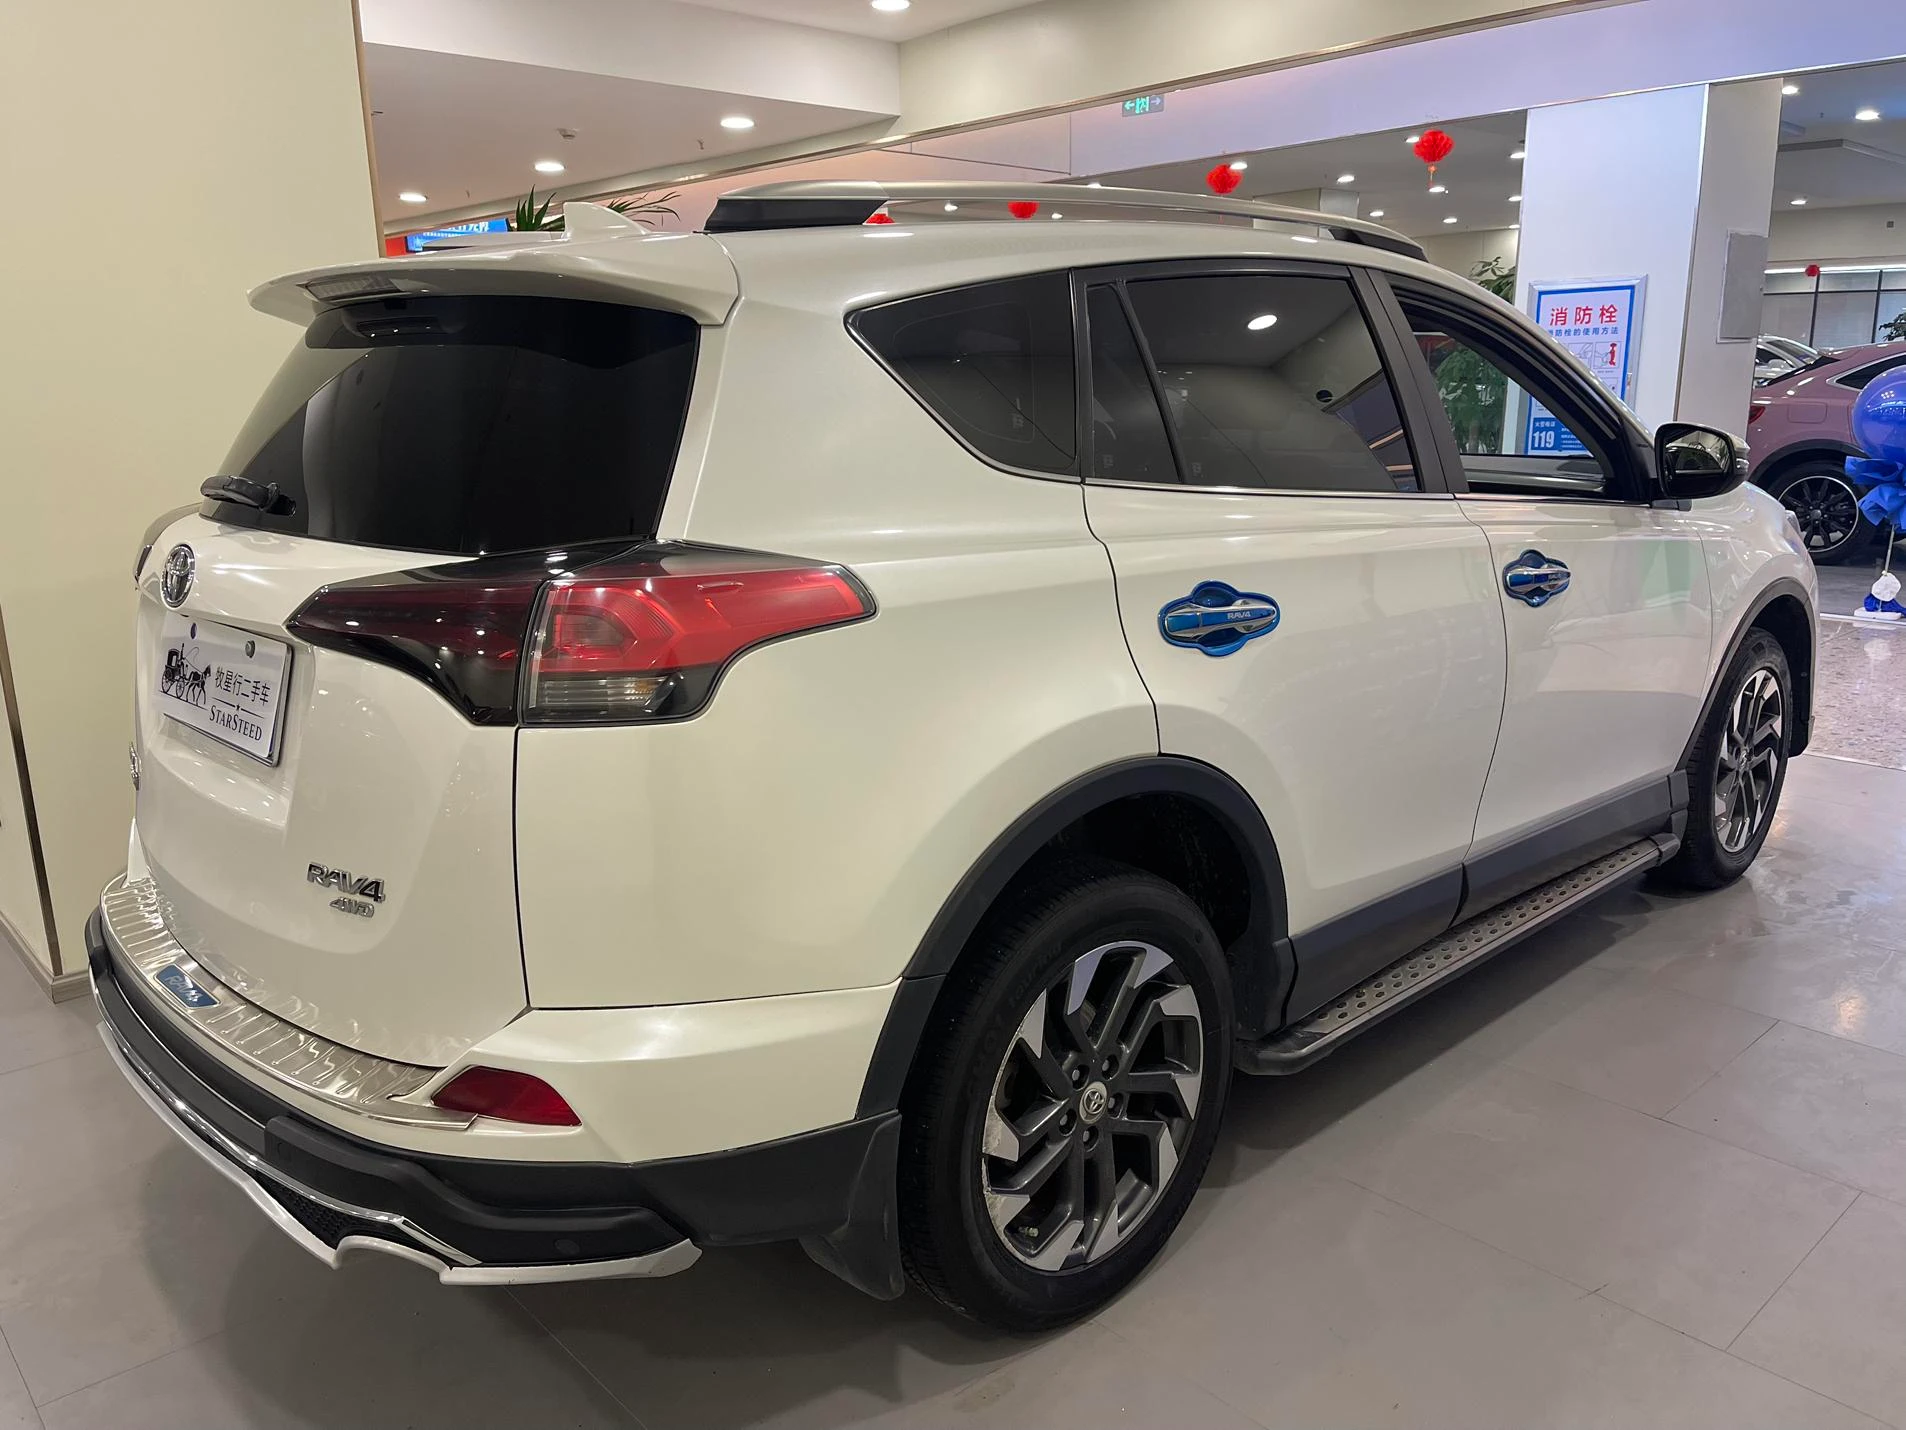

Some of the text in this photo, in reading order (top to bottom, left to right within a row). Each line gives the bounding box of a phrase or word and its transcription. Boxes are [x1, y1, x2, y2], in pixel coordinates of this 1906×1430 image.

[1549, 304, 1618, 326] 消防栓
[1533, 431, 1555, 448] 119
[1227, 611, 1251, 620] RAV4
[307, 861, 386, 903] RAV4
[329, 896, 375, 918] 4WD
